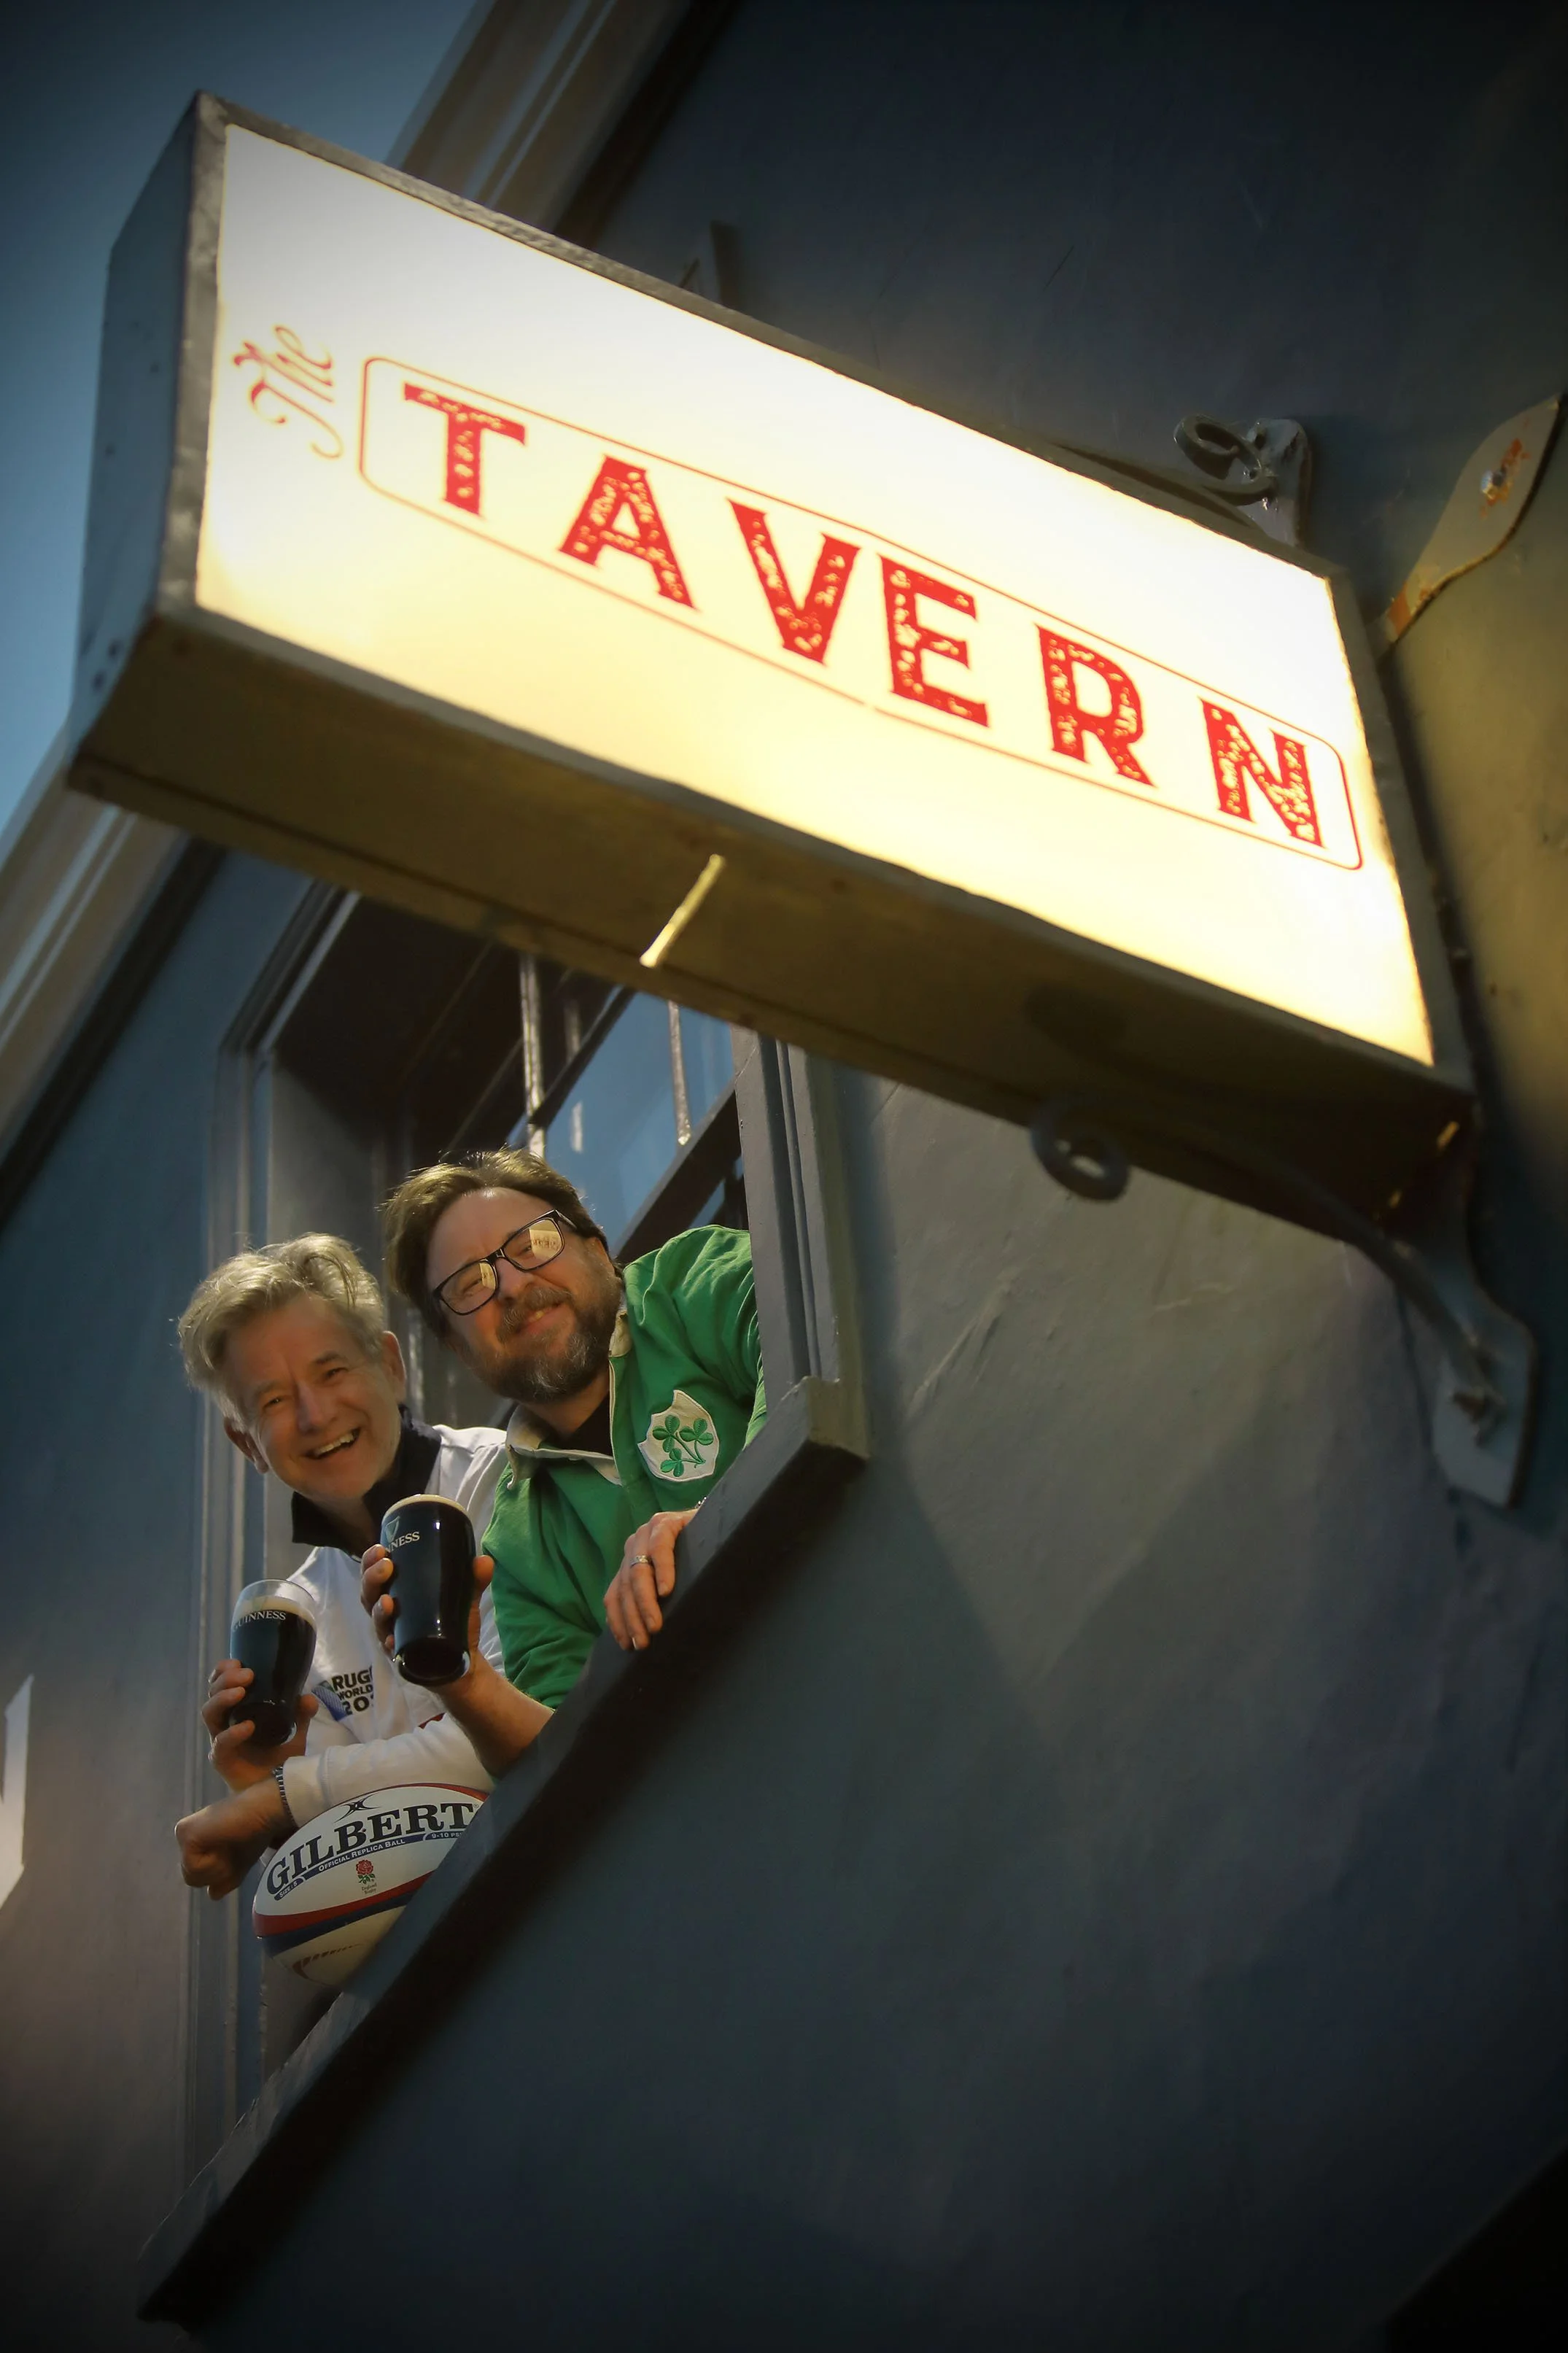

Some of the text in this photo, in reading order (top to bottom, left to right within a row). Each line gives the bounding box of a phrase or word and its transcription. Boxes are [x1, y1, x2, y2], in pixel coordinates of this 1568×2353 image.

[233, 325, 343, 460] The
[405, 383, 1324, 848] TAVERN
[331, 1665, 373, 1691] RUG
[338, 1684, 373, 1700] WORLD
[342, 1694, 373, 1716] 20
[266, 1802, 474, 1895] GILBERT
[318, 1838, 405, 1872] OFFICIAL REPLICA BALL
